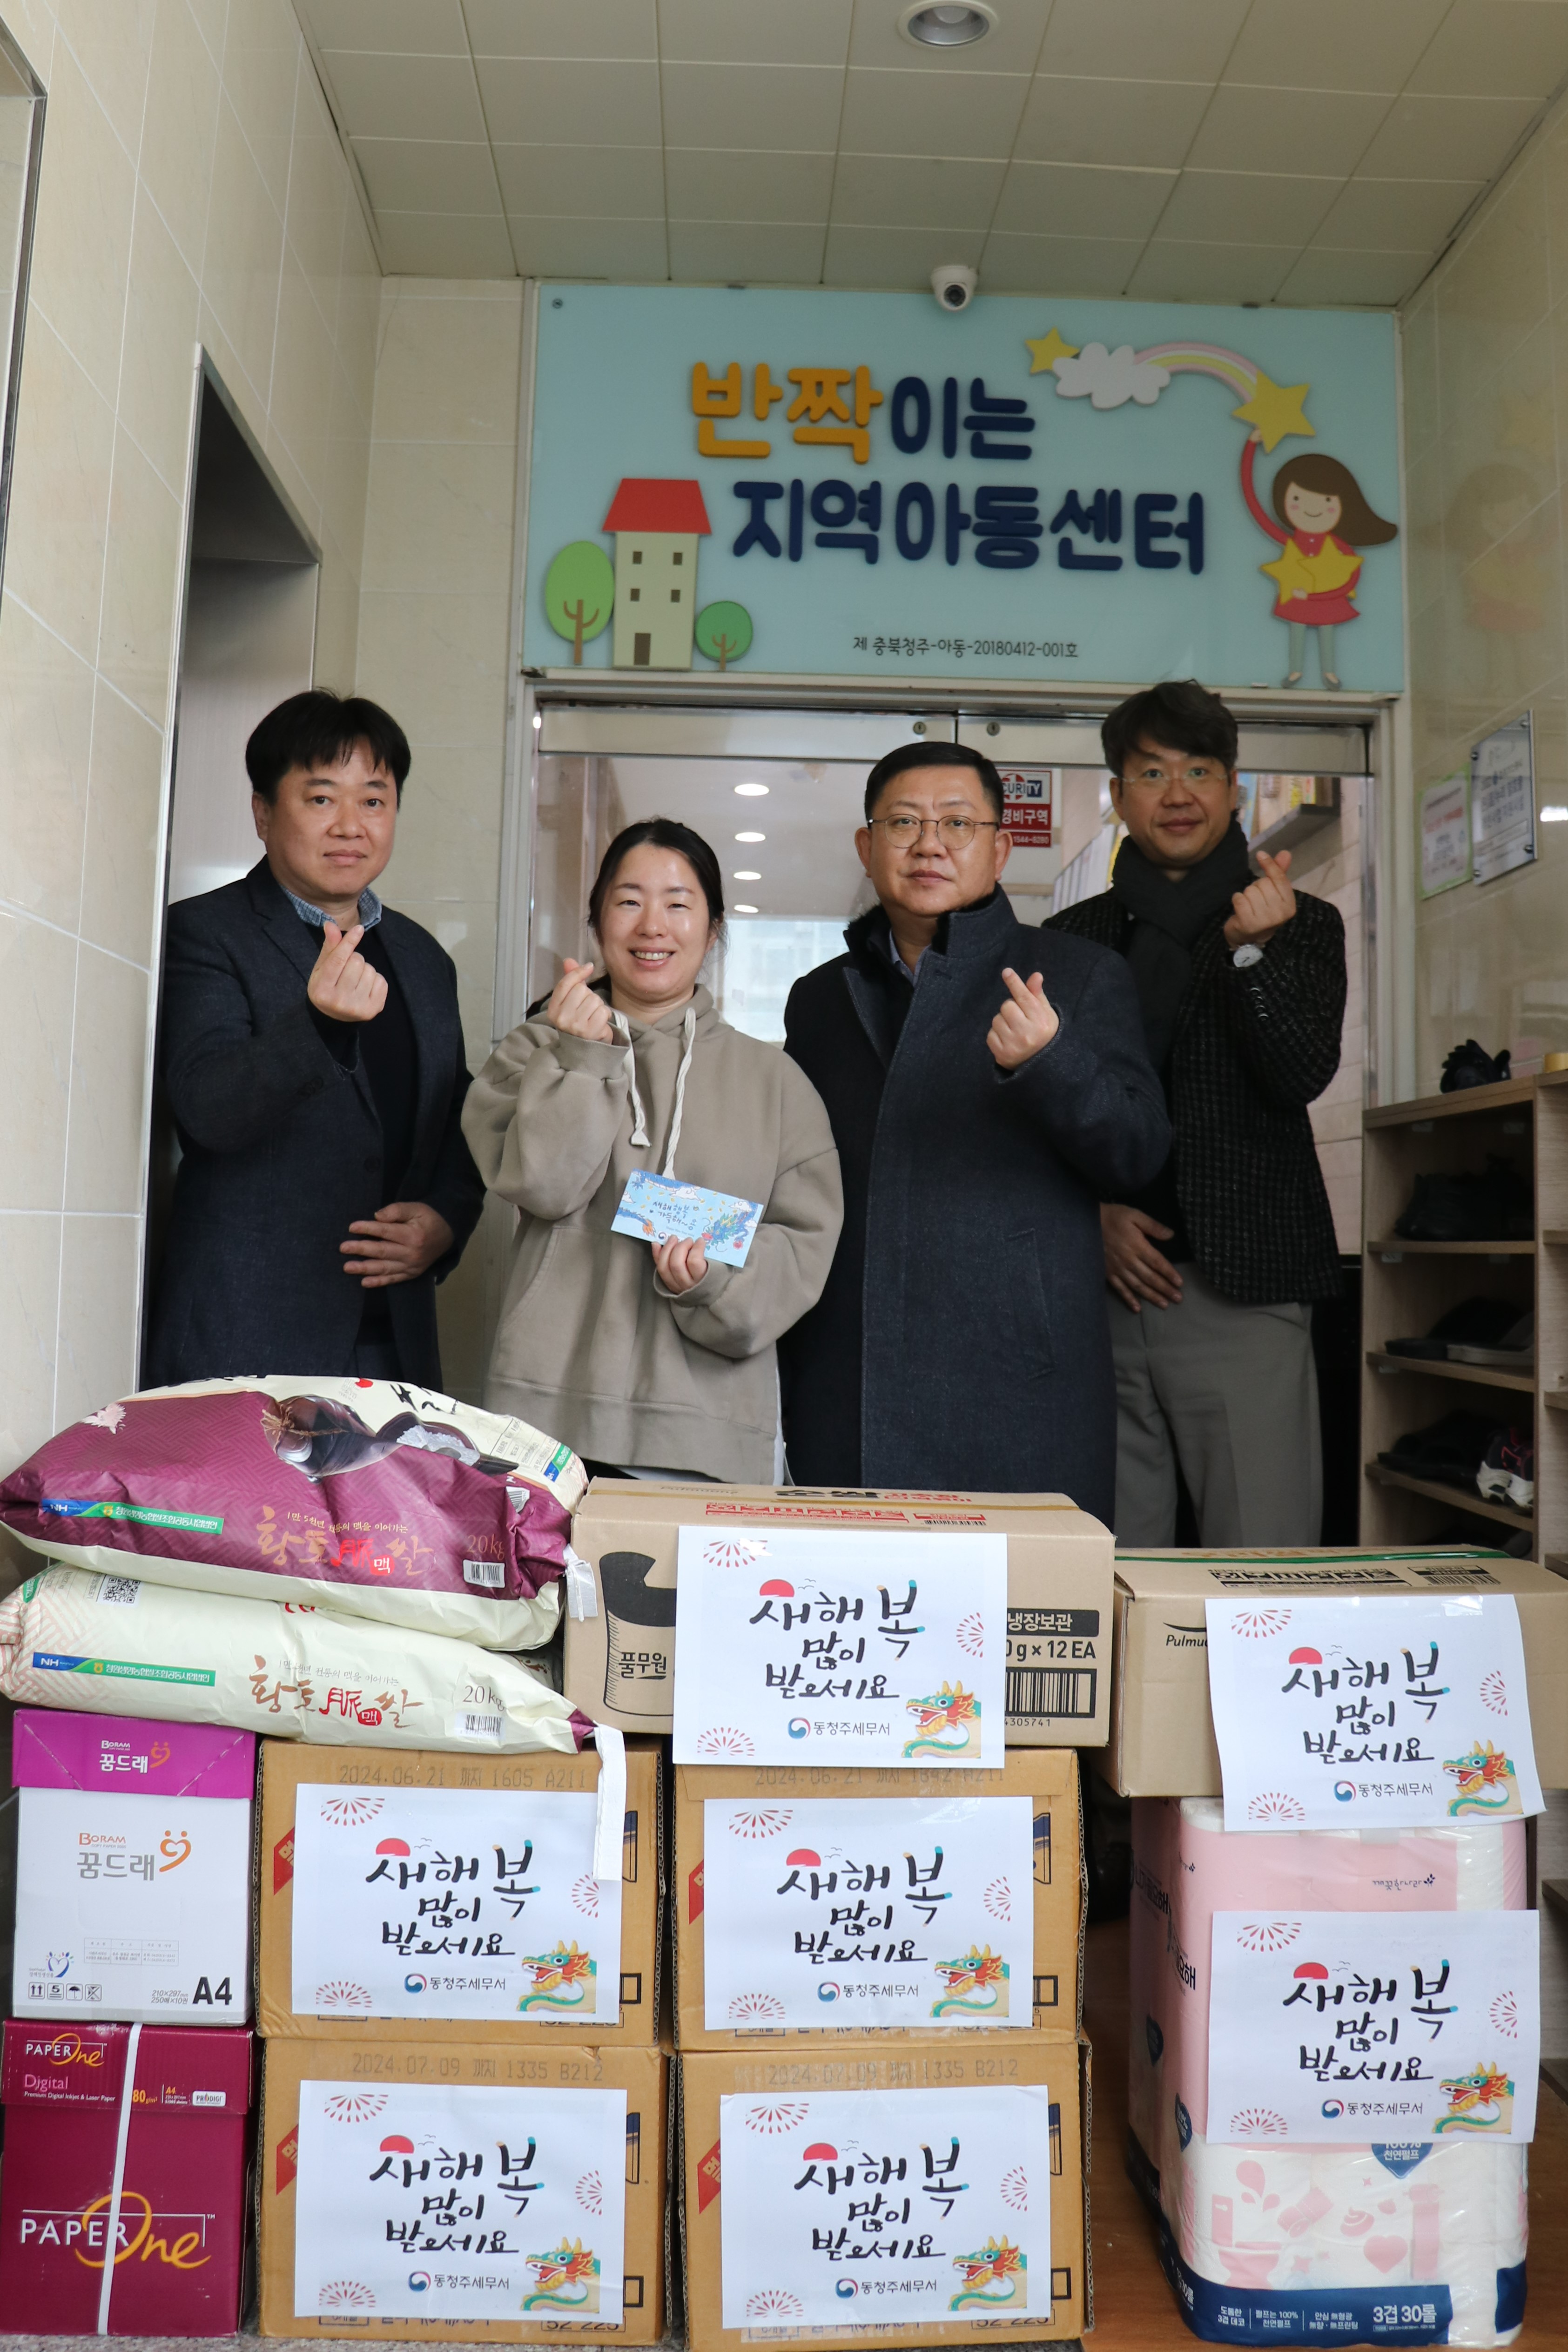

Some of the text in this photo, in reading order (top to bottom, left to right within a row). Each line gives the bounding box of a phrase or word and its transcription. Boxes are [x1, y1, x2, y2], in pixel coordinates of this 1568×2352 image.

[691, 361, 1036, 464] 반짝이는
[732, 478, 1205, 575] 지역아동센터
[853, 637, 867, 651] 제
[653, 1201, 689, 1219] 새해 행복
[353, 1521, 371, 1532] 맥을
[466, 1534, 505, 1561] 20kg
[749, 1579, 925, 1661] 새해 복
[1007, 1612, 1073, 1632] 냉장보관
[40, 1657, 59, 1667] NH
[802, 1631, 865, 1670] 많이
[344, 1671, 361, 1682] 맥을
[619, 1652, 666, 1679] 풀무원
[766, 1663, 900, 1699] 받으세요
[1281, 1641, 1451, 1723] 새해 복
[463, 1685, 505, 1712] 20kg
[813, 1721, 890, 1736] 동청주세무서
[1336, 1696, 1396, 1734] 많이
[1303, 1729, 1435, 1765] 받으세요
[99, 1753, 148, 1773] 꿈드래
[493, 1768, 533, 1787] 1605
[545, 1769, 586, 1789] A211
[1358, 1782, 1434, 1797] 동청주세무서
[77, 1852, 155, 1881] 꿈드래
[366, 1850, 478, 1890] 새해
[492, 1839, 541, 1921] 복
[777, 1846, 953, 1927] 새해 복
[418, 1891, 480, 1928] 많이
[830, 1900, 893, 1936] 많이
[382, 1921, 515, 1956] 받으세요
[794, 1931, 928, 1964] 받으세요
[192, 1976, 233, 2005] A4
[430, 1976, 506, 1991] 동청주세무서
[843, 1984, 919, 1998] 동청주세무서
[1283, 1959, 1459, 2043] 새해 복
[1335, 2012, 1399, 2052] 많이
[352, 2052, 461, 2076] 2024.07.09
[508, 2060, 548, 2079] 1335
[560, 2062, 603, 2082] B212
[923, 2060, 964, 2080] 1335
[976, 2059, 1019, 2077] B212
[1299, 2045, 1434, 2082] 받으세요
[24, 2074, 69, 2092] Digital
[166, 2086, 176, 2095] A4
[1347, 2101, 1423, 2116] 동청주세무서
[1383, 2150, 1419, 2160] 천연펄프
[369, 2136, 544, 2218] 새해 복
[794, 2153, 907, 2195] 새해
[919, 2136, 969, 2220] 복
[422, 2188, 485, 2226] 많이
[848, 2192, 911, 2231] 많이
[21, 2218, 129, 2247] PAPER
[386, 2220, 519, 2254] 받으세요
[812, 2227, 947, 2261] 받으세요
[434, 2275, 510, 2290] 동청주세무서
[861, 2279, 937, 2294] 동청주세무서
[1218, 2314, 1245, 2326] 3겹 데코
[1256, 2309, 1299, 2319] 펄프는 100%
[1263, 2319, 1291, 2328] 천연펄프
[1315, 2312, 1329, 2321] 안심
[1373, 2304, 1437, 2324] 3겹 30롤
